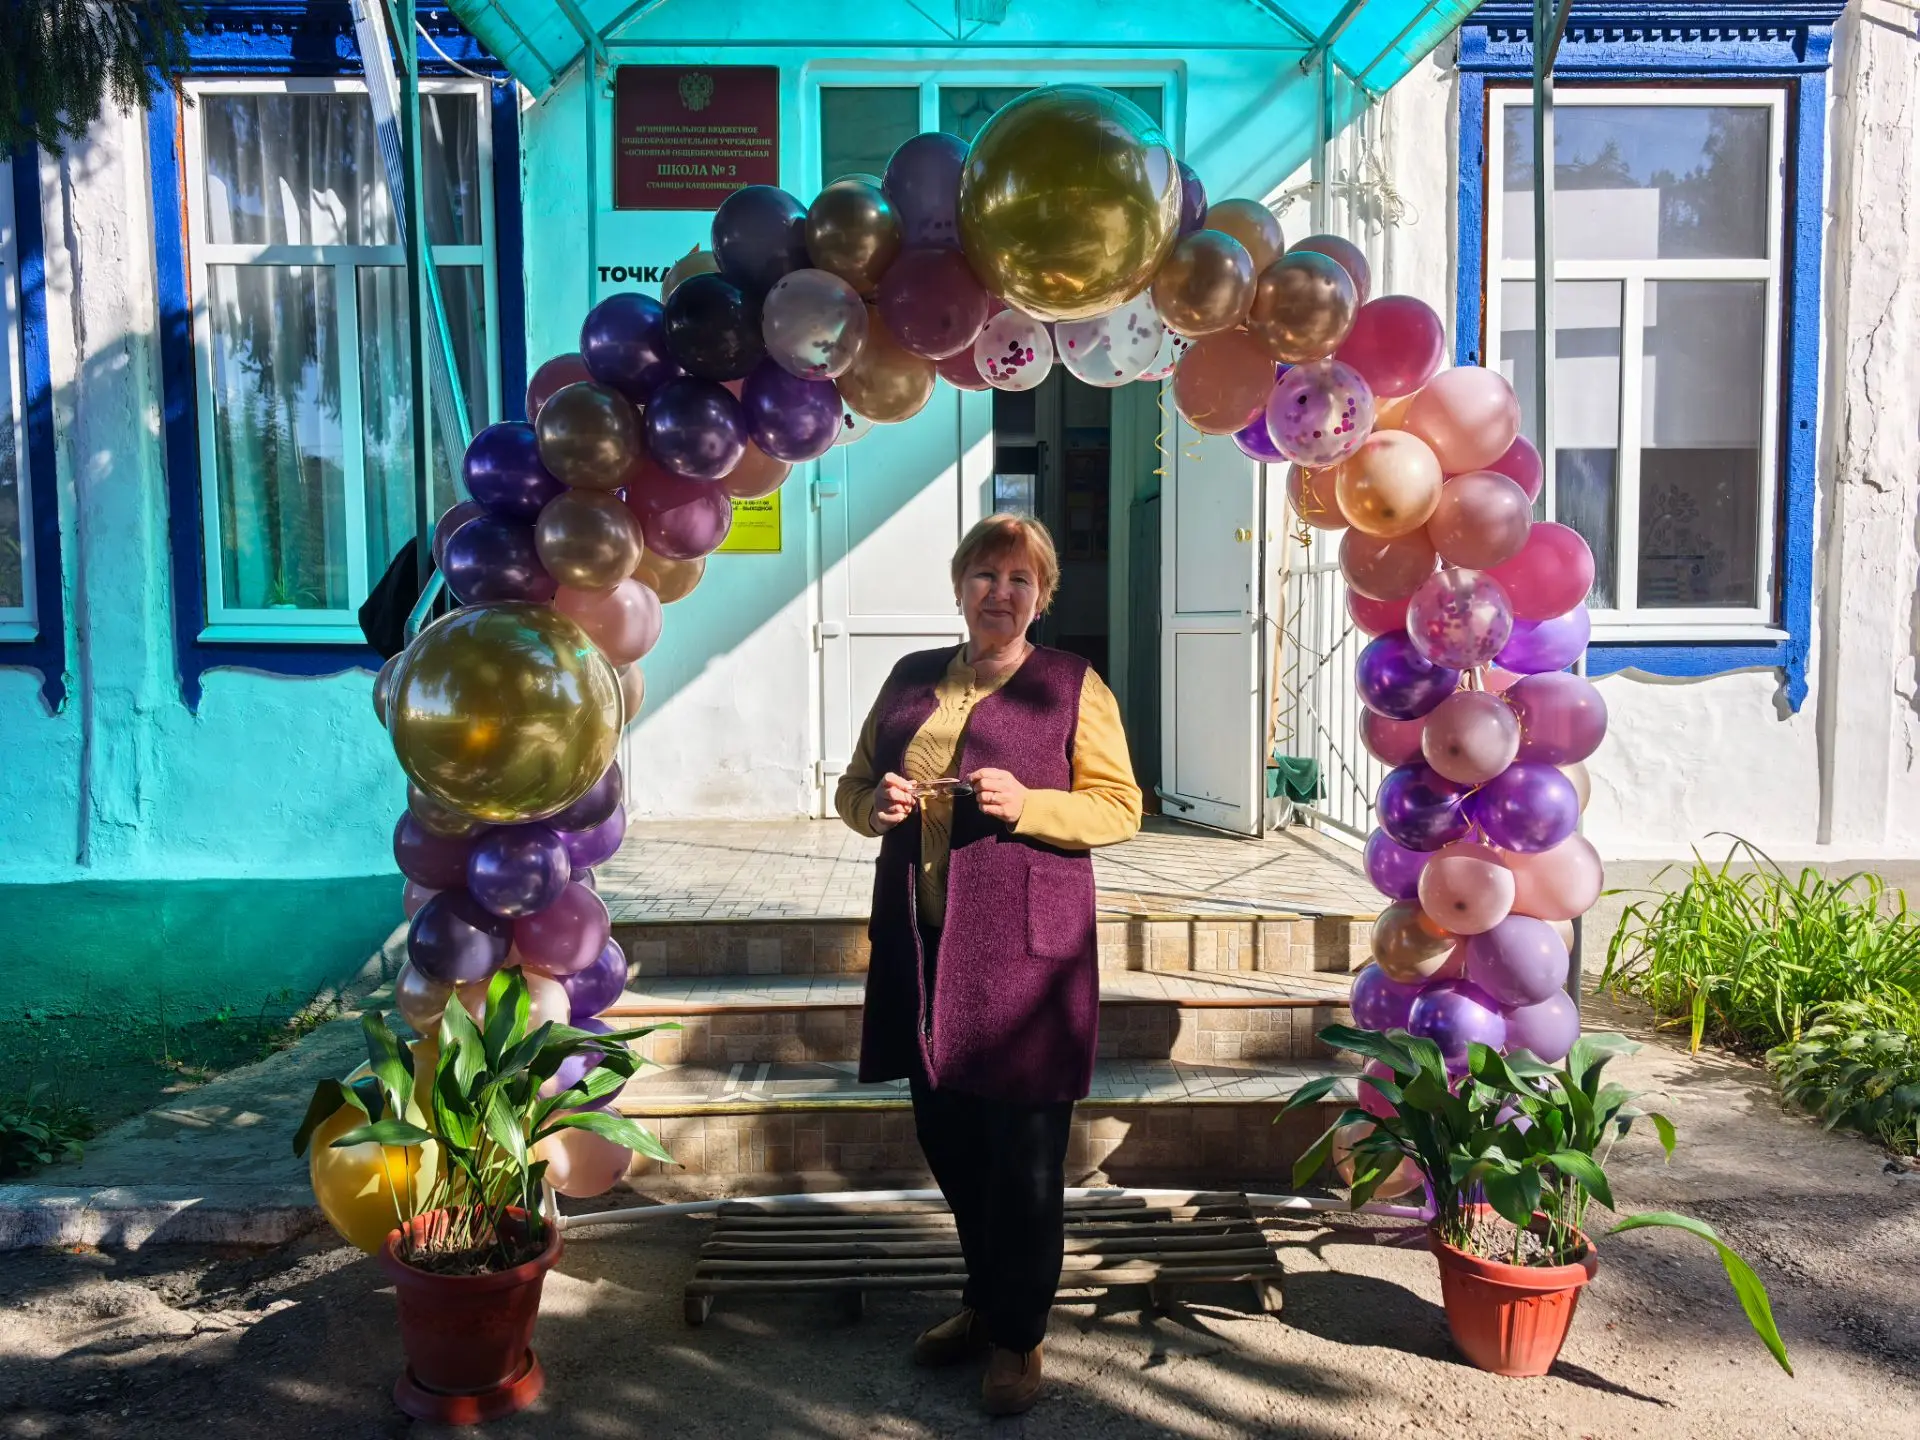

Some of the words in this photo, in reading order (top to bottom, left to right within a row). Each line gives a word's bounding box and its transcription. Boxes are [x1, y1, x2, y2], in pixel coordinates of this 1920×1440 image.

[708, 126, 759, 134] БЮДЖЕТНОЕ
[720, 138, 773, 146] УЧРЕЖДЕНИЕ
[657, 164, 708, 176] ШКОЛА
[711, 164, 726, 176] №
[728, 164, 737, 176] 3
[646, 181, 684, 189] СТАНИЦЫ
